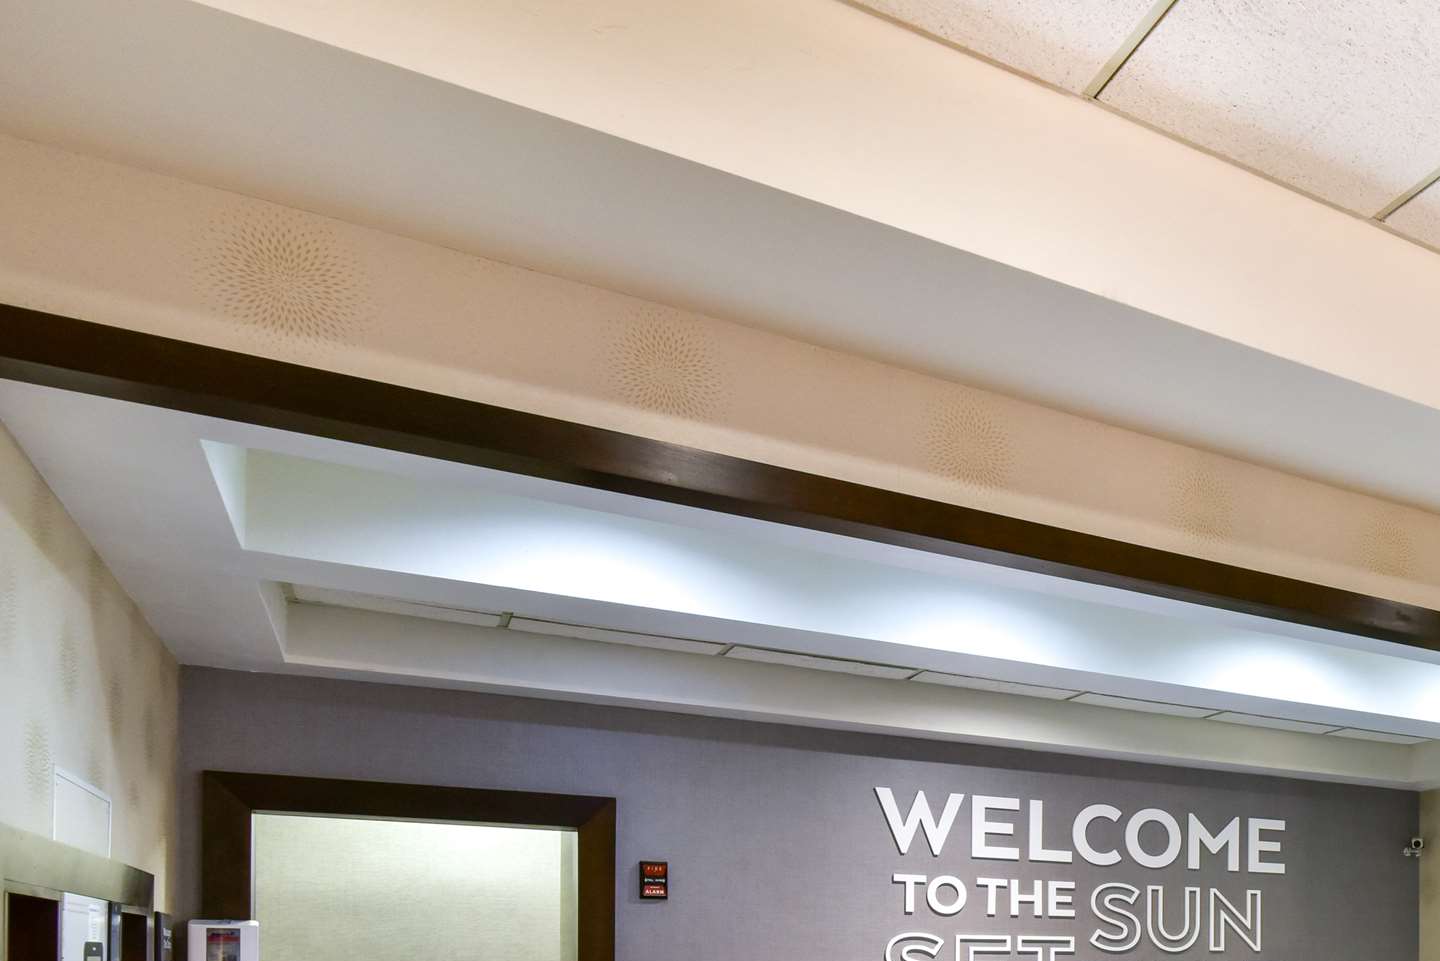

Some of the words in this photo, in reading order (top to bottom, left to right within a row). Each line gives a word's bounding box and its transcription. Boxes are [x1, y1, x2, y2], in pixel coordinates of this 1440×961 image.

[873, 786, 1286, 874] WELCOME
[892, 873, 968, 916] TO
[976, 876, 1076, 918] THE
[1089, 882, 1262, 953] SUN
